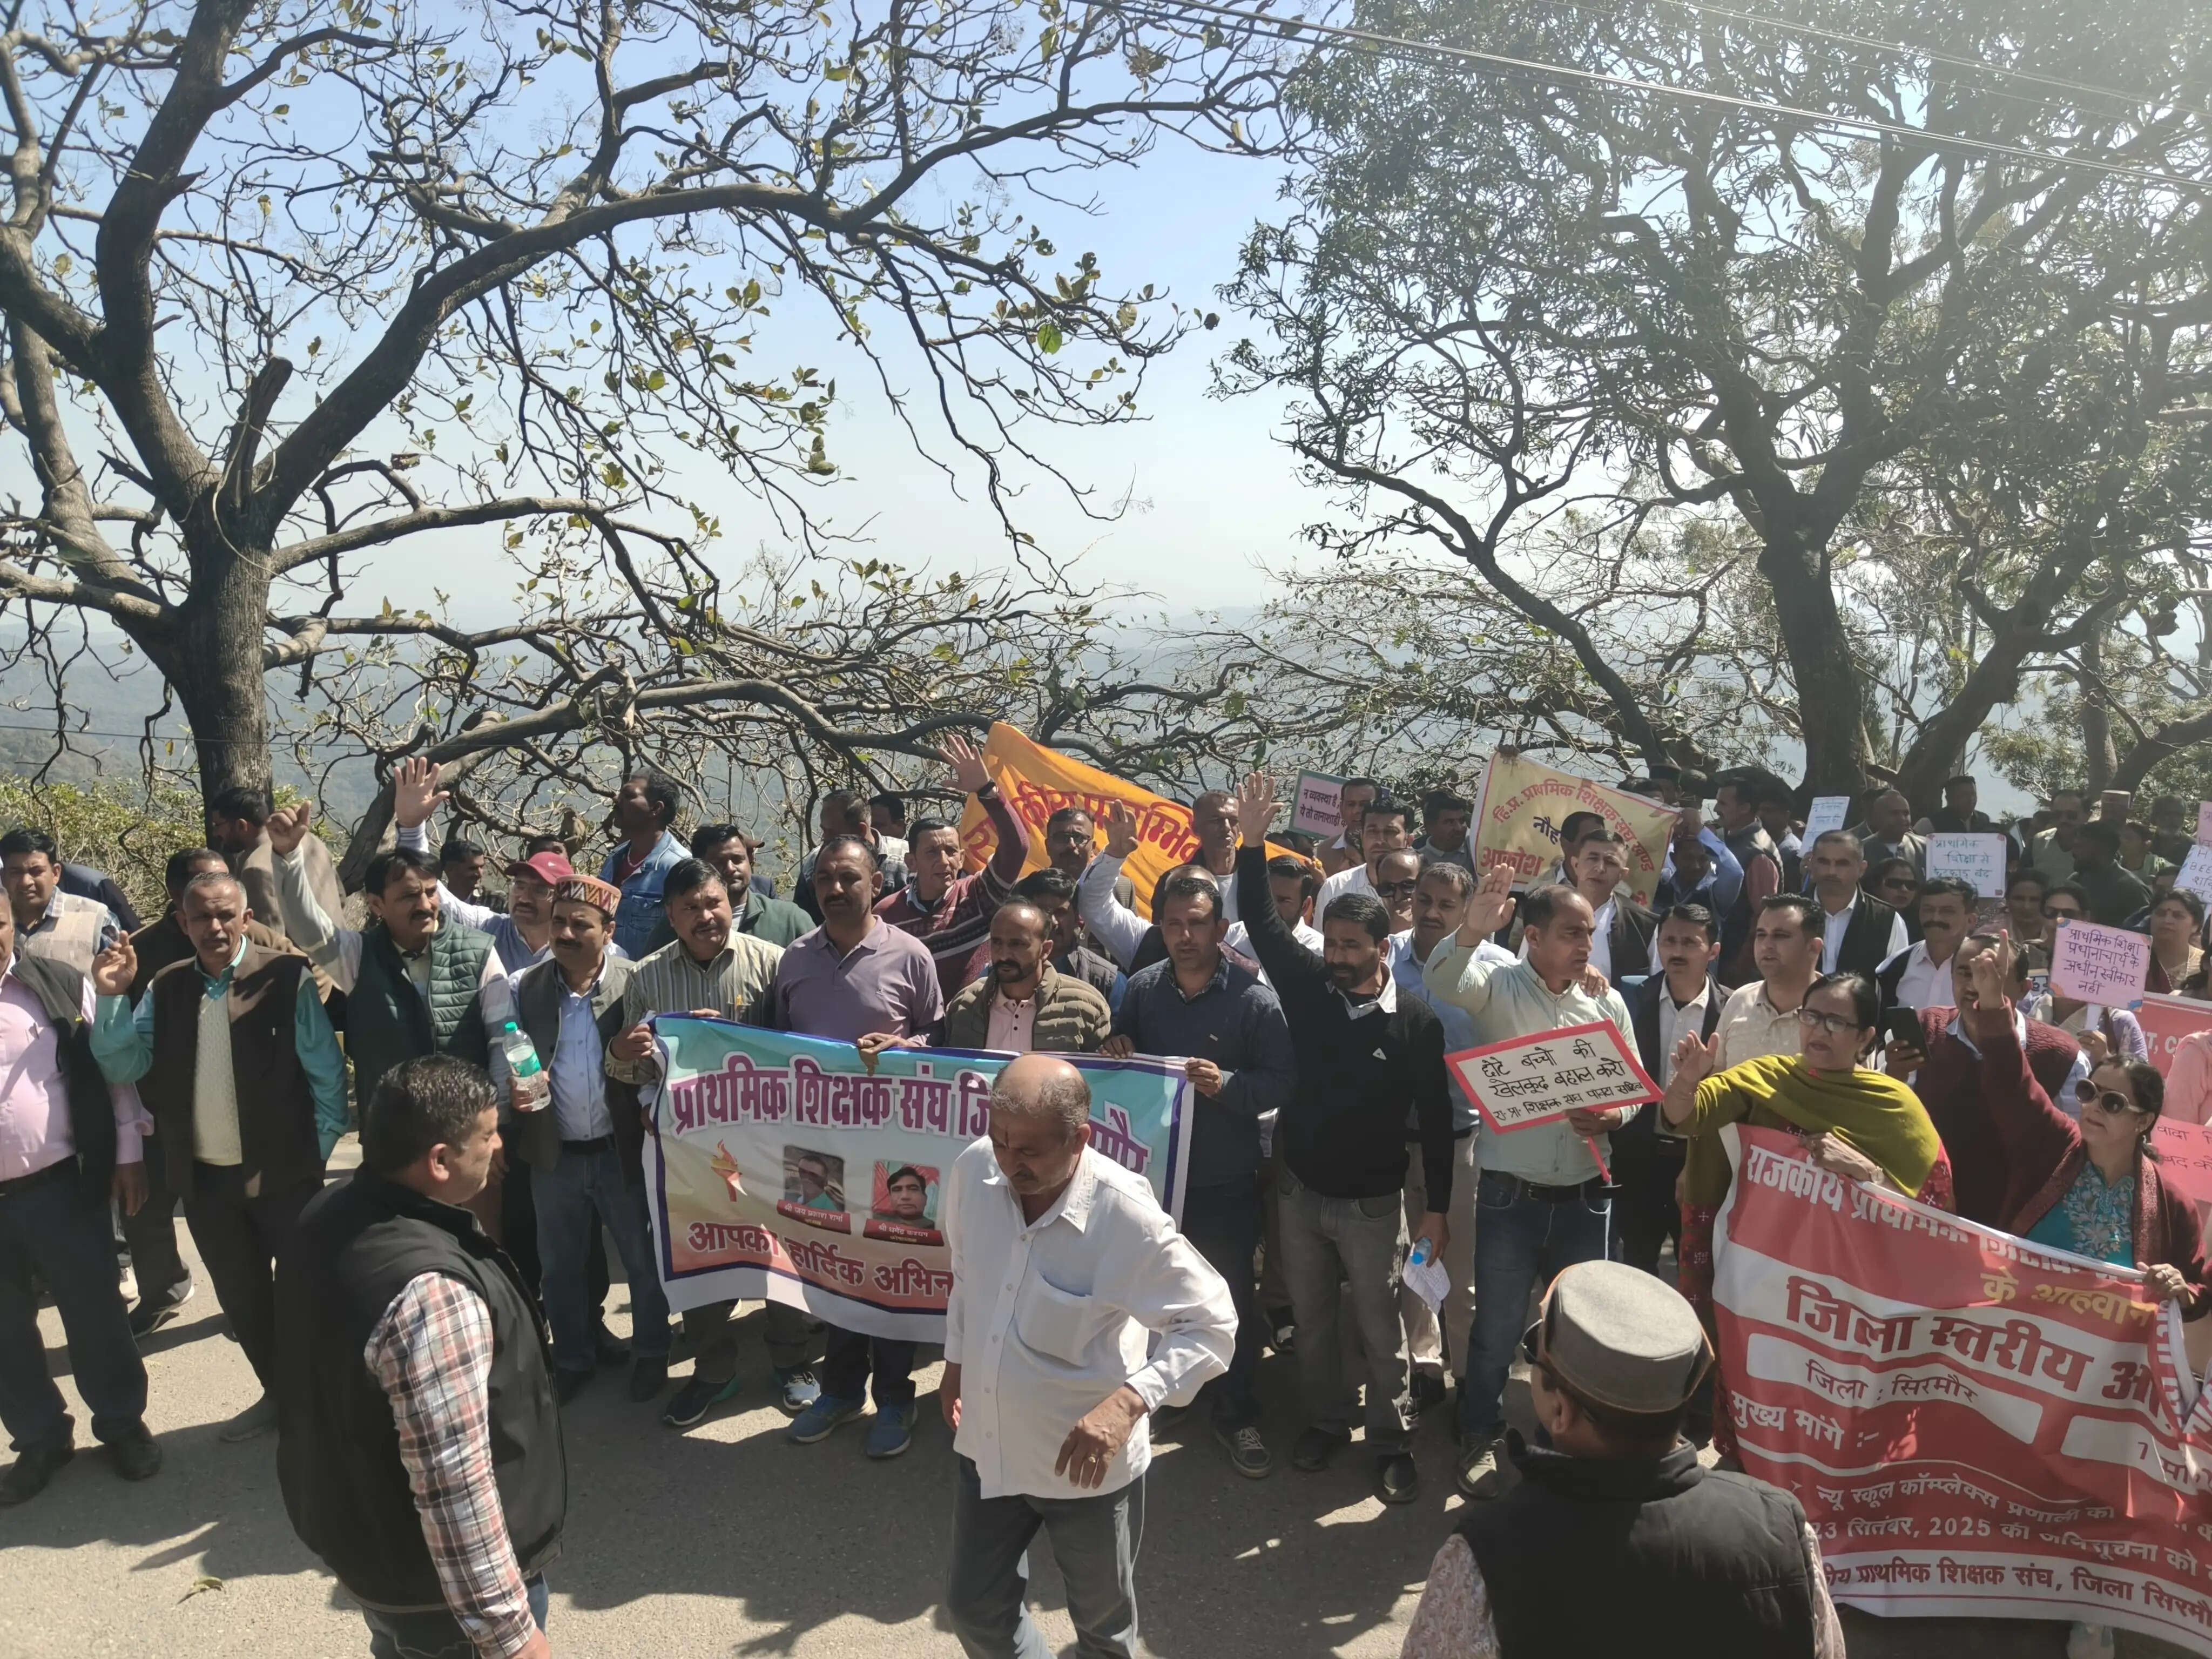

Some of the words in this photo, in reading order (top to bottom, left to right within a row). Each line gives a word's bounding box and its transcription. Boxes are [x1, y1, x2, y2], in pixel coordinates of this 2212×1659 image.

[1521, 778, 1576, 802] प्राथमिक
[1575, 784, 1621, 822] शिक्षक
[1533, 816, 1562, 845] नौह
[2065, 941, 2130, 967] प्रधानाचार्य
[2129, 954, 2139, 969] के
[2067, 928, 2112, 946] प्राथमिक
[2112, 935, 2144, 955] शिक्षा
[1573, 1038, 1596, 1059] की
[671, 1055, 789, 1135] प्राथमिक
[794, 1058, 892, 1125] शिक्षक
[900, 1064, 952, 1133] संघ
[960, 1071, 990, 1137] जि
[1488, 1078, 1549, 1098] खेलकूद
[1554, 1066, 1595, 1087] बहाल
[1596, 1057, 1624, 1079] करो
[1523, 1098, 1562, 1114] शिक्षक
[1747, 1144, 1844, 1212] राजकीय
[784, 1203, 792, 1212] श्री
[878, 1223, 887, 1232] श्री
[688, 1222, 779, 1256] आपका
[784, 1236, 864, 1286] हार्दिक
[873, 1259, 954, 1297] अभिन
[1980, 1265, 2019, 1305] के
[1785, 1275, 1920, 1353] जिला
[1929, 1316, 2095, 1393] स्तरीय
[1805, 1358, 1869, 1400] जिला
[1892, 1373, 1979, 1403] सिरमौर
[1730, 1390, 1786, 1432] मुख्य
[2138, 1441, 2148, 1460] 7
[1816, 1485, 1845, 1511] न्यू
[1851, 1481, 1896, 1508] स्कूल
[1847, 1515, 1920, 1539] सितंबर,
[1928, 1516, 1991, 1537] 2025
[2164, 1548, 2197, 1577] को
[1856, 1556, 1931, 1583] प्राथमिक
[1937, 1556, 2006, 1585] शिक्षक
[2071, 1566, 2134, 1601] जिला
[2141, 1580, 2212, 1628] सिरमौ
